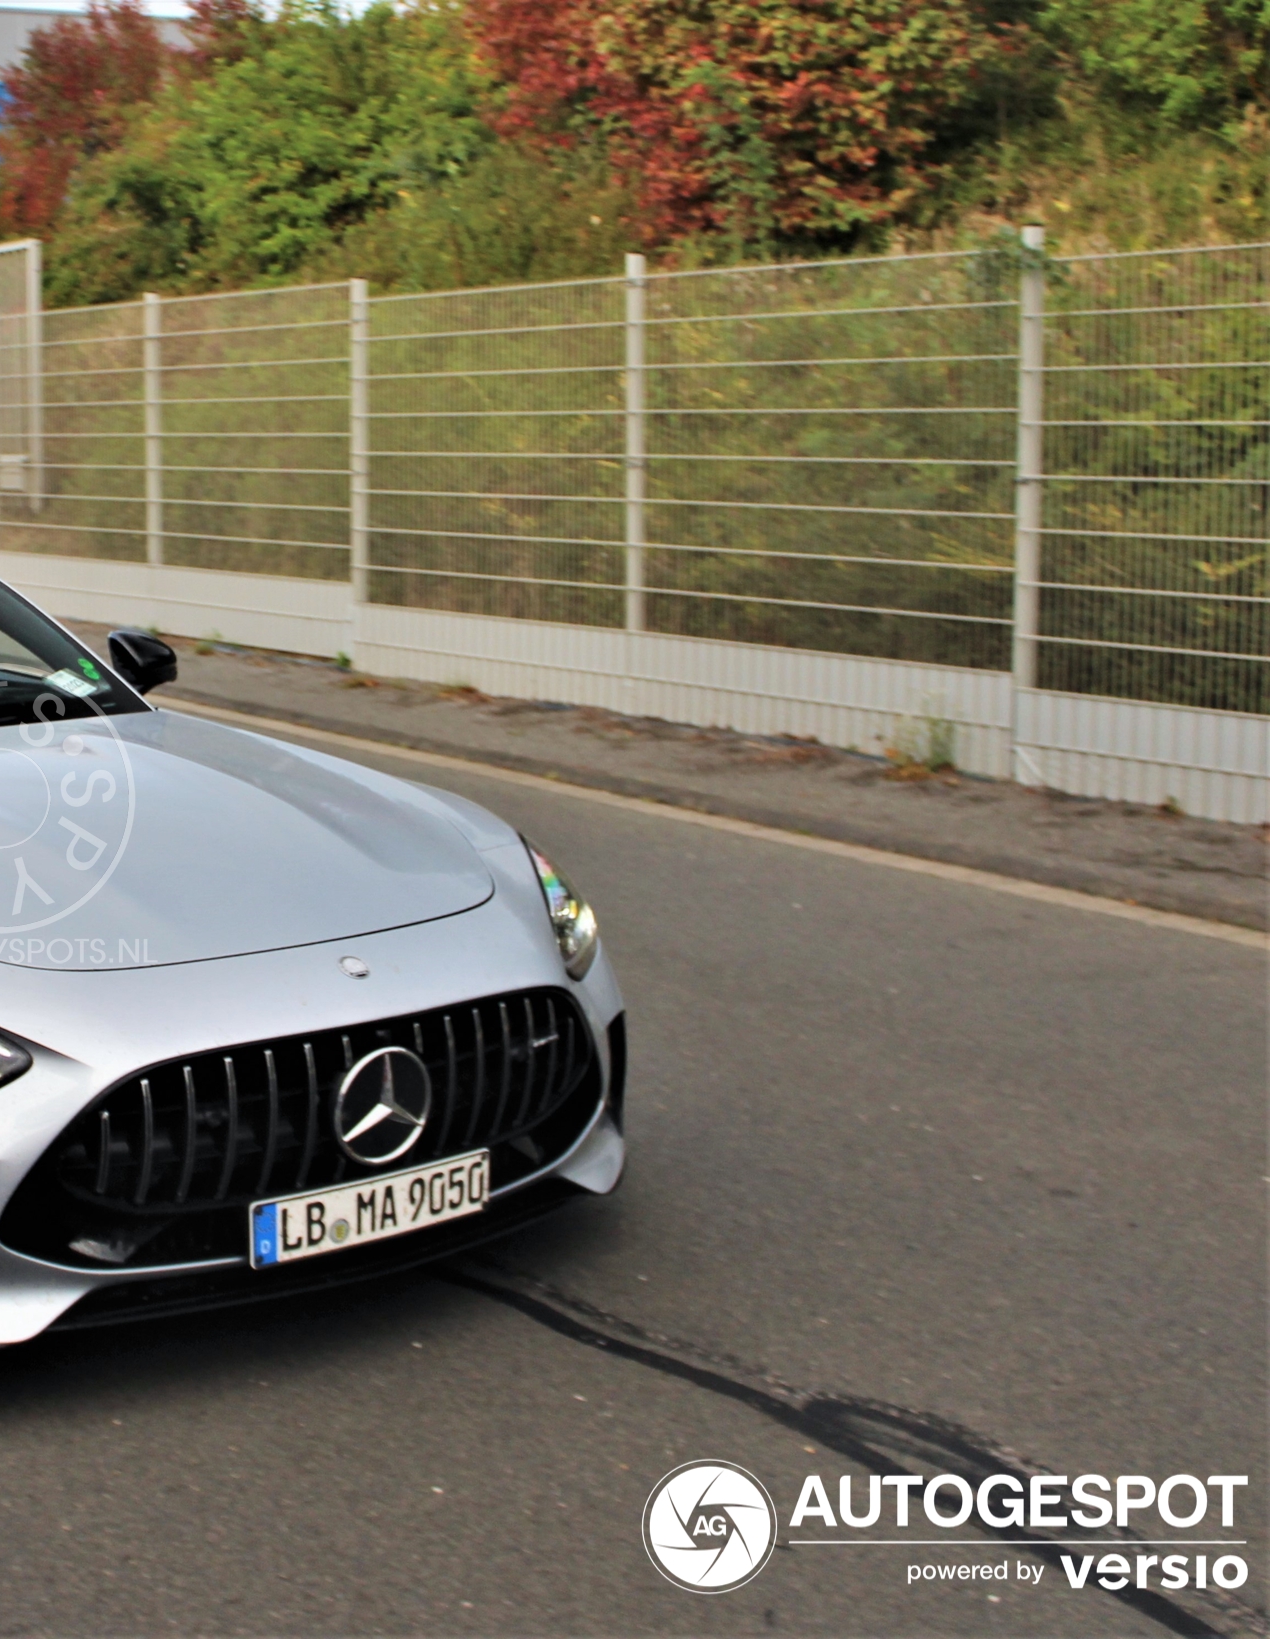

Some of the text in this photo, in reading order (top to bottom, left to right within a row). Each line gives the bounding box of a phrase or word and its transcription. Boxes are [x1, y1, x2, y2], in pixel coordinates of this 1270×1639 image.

[281, 1161, 485, 1252] LB MA 9050
